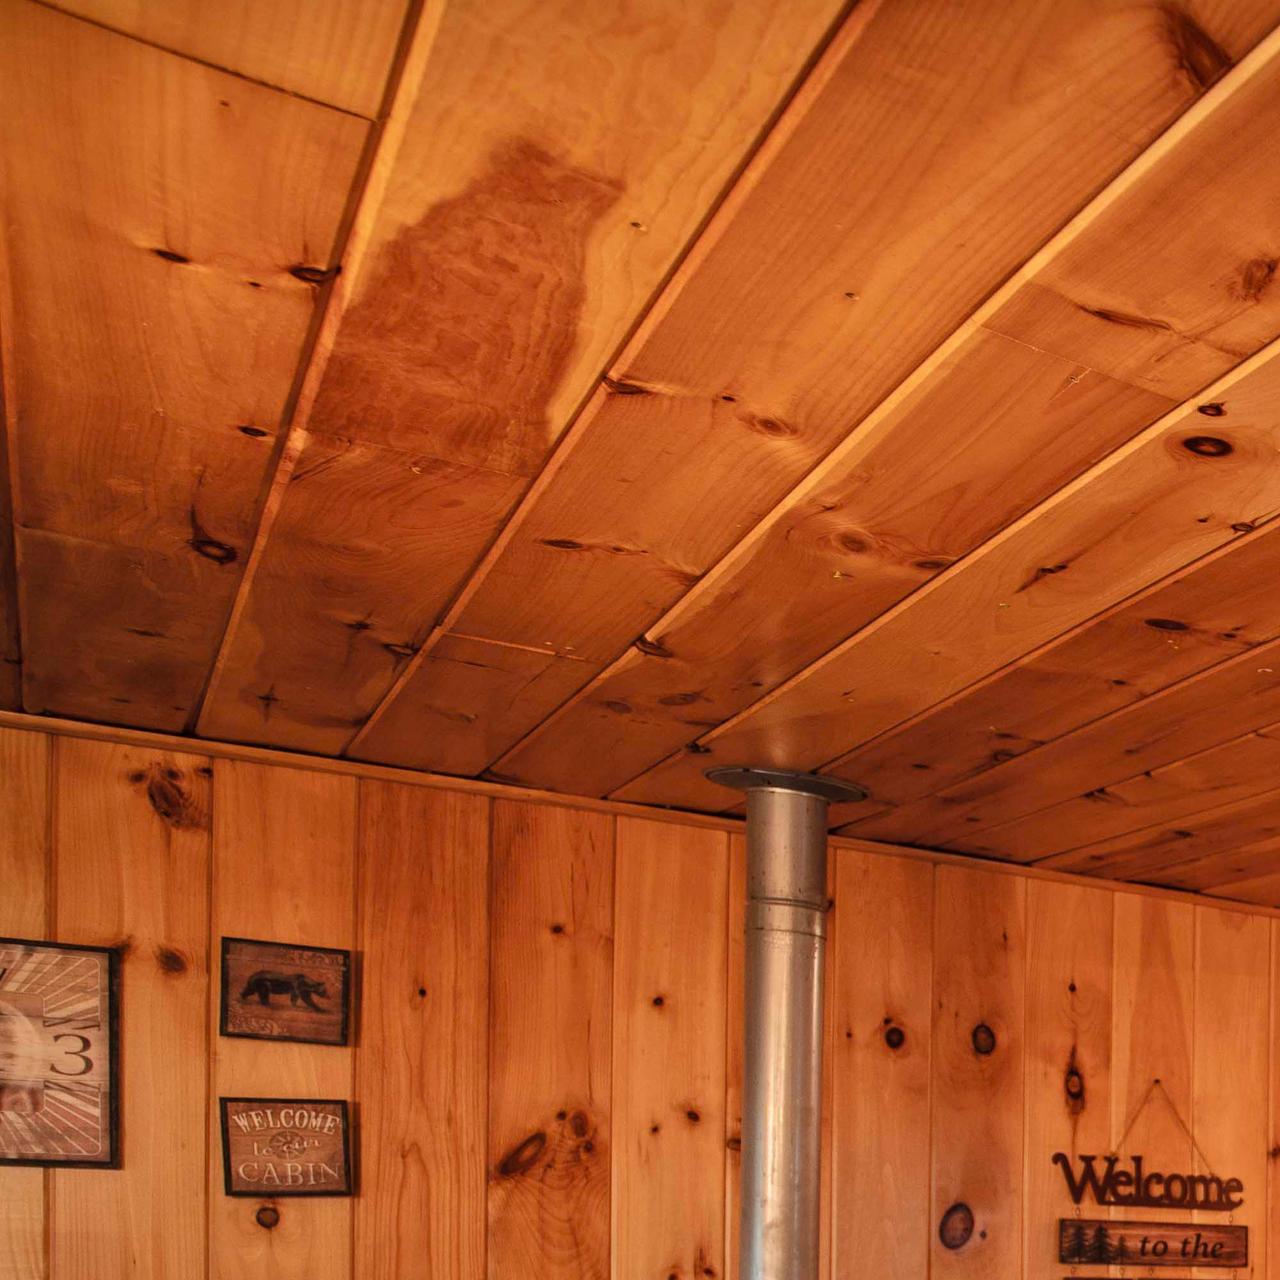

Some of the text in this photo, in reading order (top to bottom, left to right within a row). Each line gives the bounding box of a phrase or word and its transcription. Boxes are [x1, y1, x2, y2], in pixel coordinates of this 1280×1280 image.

[50, 1033, 94, 1077] 3
[233, 1109, 340, 1135] WELCOME
[253, 1138, 321, 1157] to our
[238, 1162, 340, 1186] CABIN
[1052, 1152, 1243, 1209] Welcome
[1139, 1232, 1225, 1259] to the
